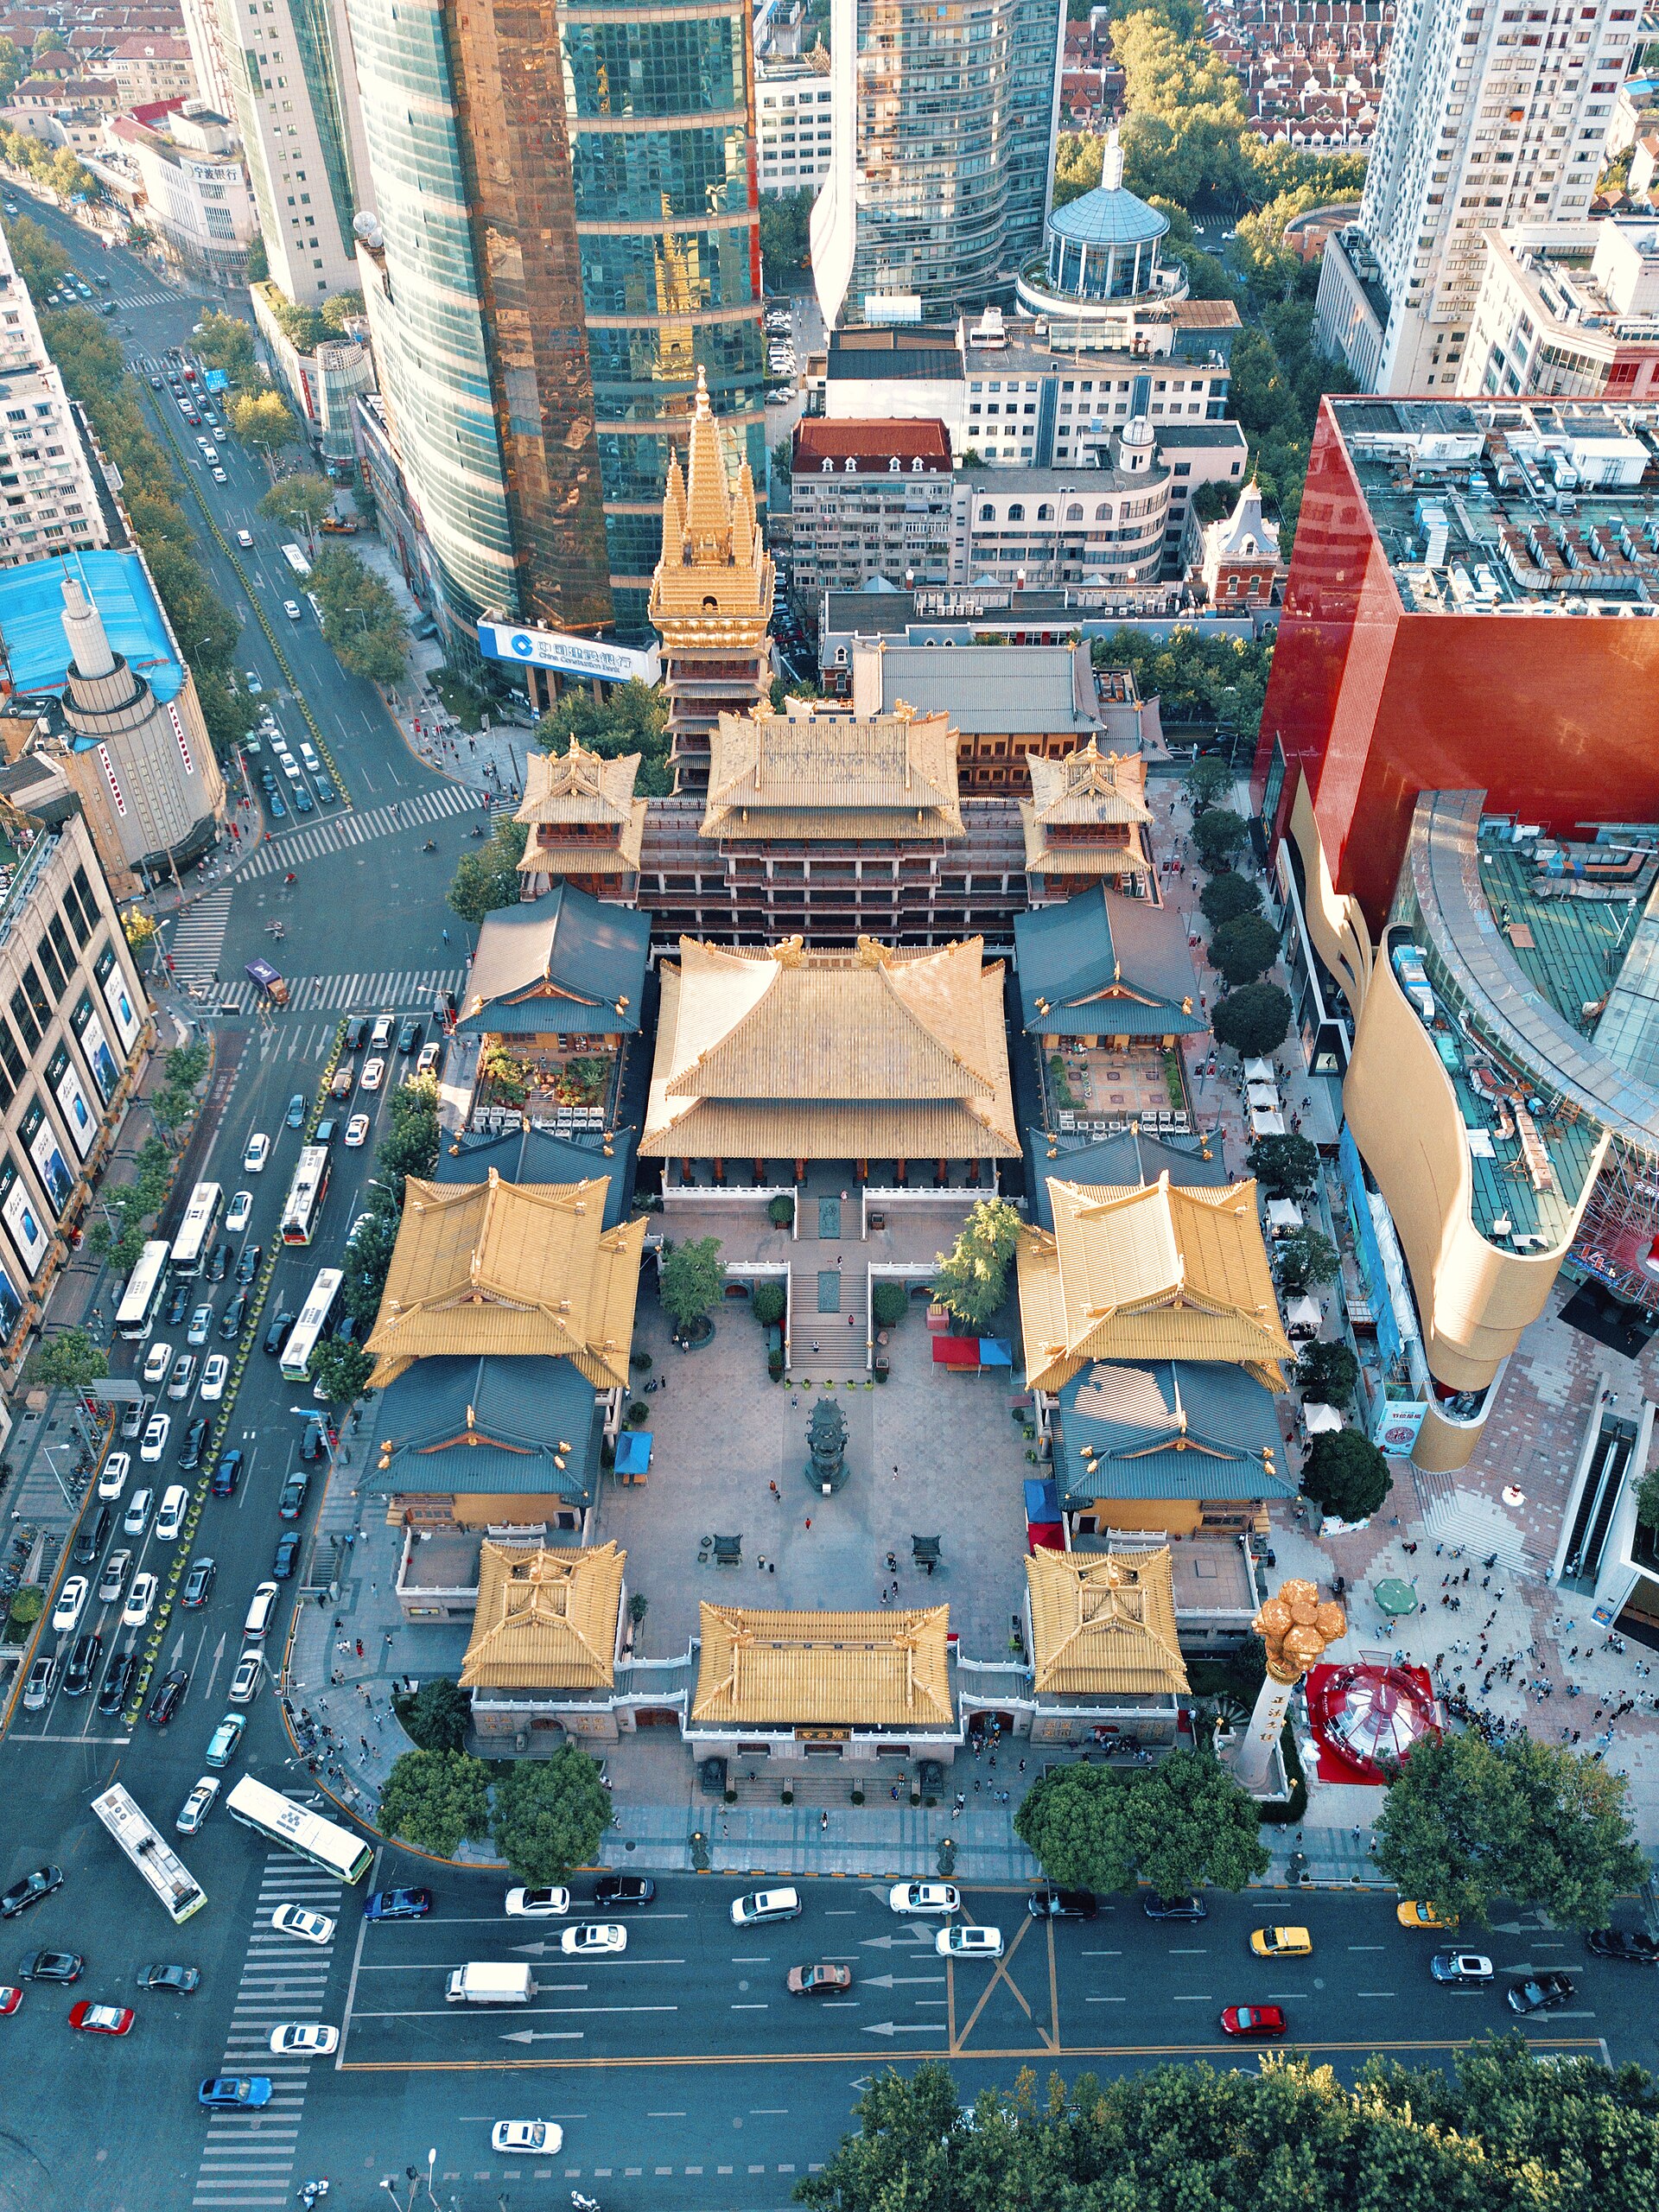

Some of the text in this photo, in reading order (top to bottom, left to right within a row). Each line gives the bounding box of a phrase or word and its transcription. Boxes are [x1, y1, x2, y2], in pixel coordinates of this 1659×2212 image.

[194, 166, 237, 180] 宁波银行
[537, 641, 632, 668] 中国建设银行
[539, 652, 620, 673] China Construction Bank
